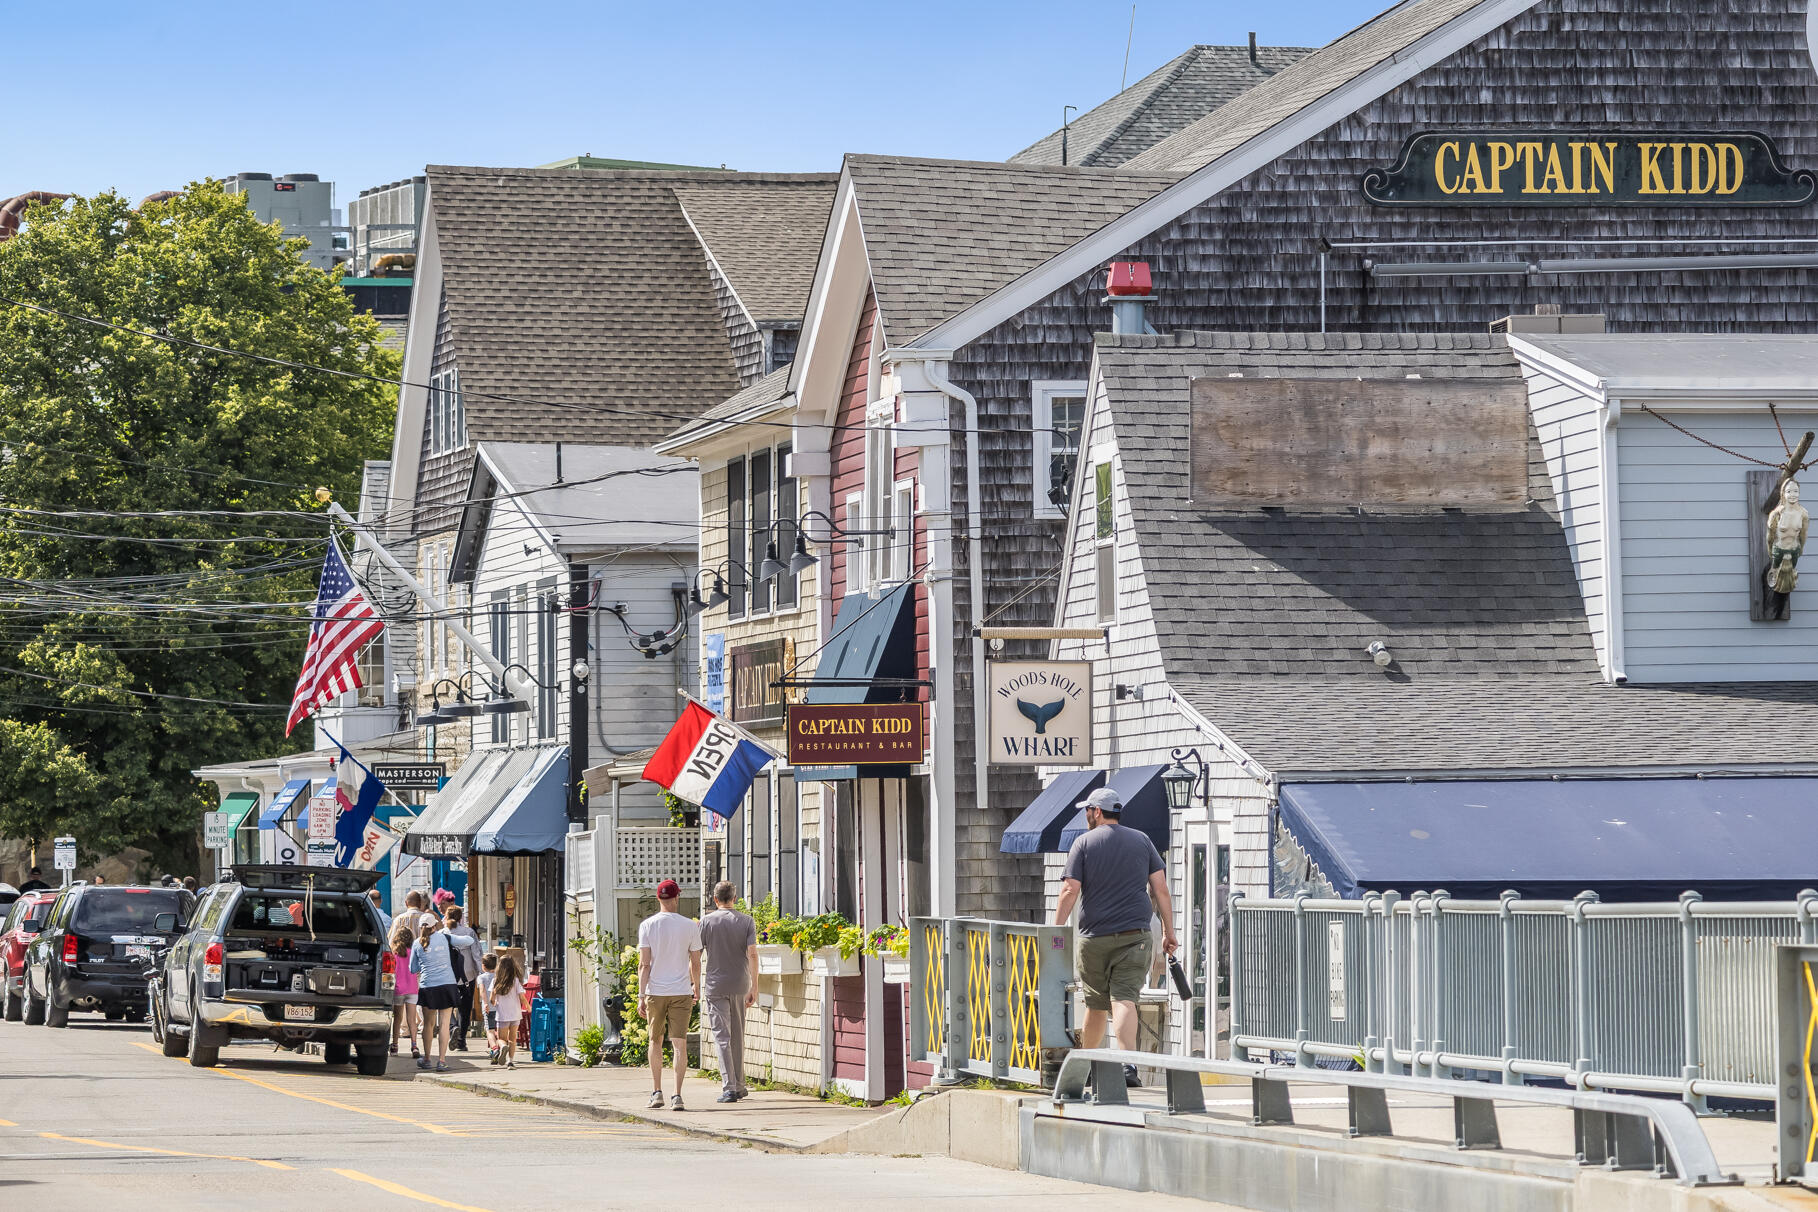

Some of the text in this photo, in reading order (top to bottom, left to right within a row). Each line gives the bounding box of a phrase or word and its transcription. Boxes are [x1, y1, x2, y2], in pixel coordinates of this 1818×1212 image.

[1434, 141, 1744, 195] CAPTAIN KIDD
[997, 670, 1085, 701] WOODS HOLE
[798, 717, 912, 735] CAPTAIN KIDD
[798, 741, 913, 751] RESTAURANT & BAR
[1002, 736, 1080, 757] WHARF
[378, 769, 439, 778] MASTERSON
[361, 831, 381, 863] OPEN
